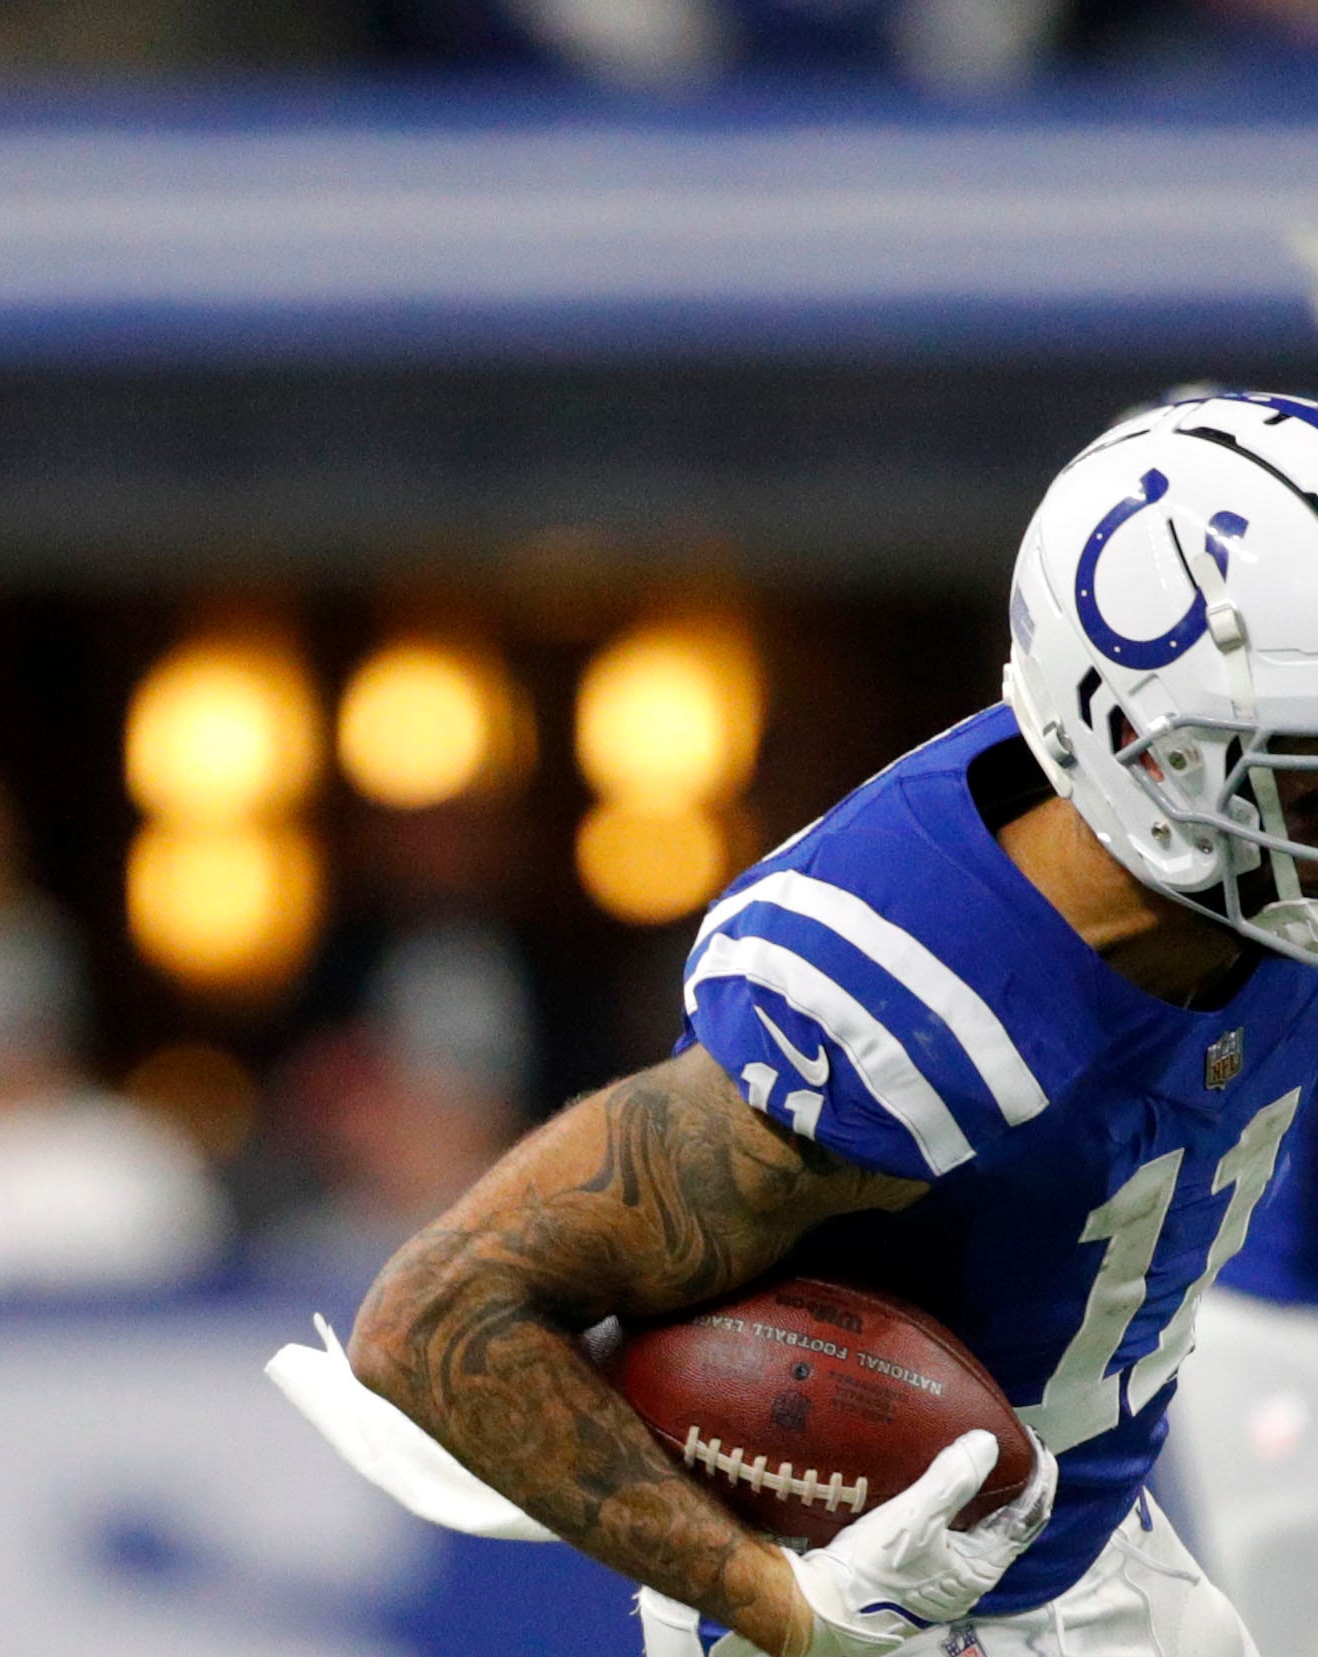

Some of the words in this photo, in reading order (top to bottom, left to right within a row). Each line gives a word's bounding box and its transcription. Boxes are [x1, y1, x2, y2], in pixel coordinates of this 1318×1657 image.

[741, 1061, 825, 1138] 11
[1012, 1086, 1303, 1455] 11
[752, 1322, 848, 1360] FOOTBALL
[856, 1352, 943, 1395] NATIONAL
